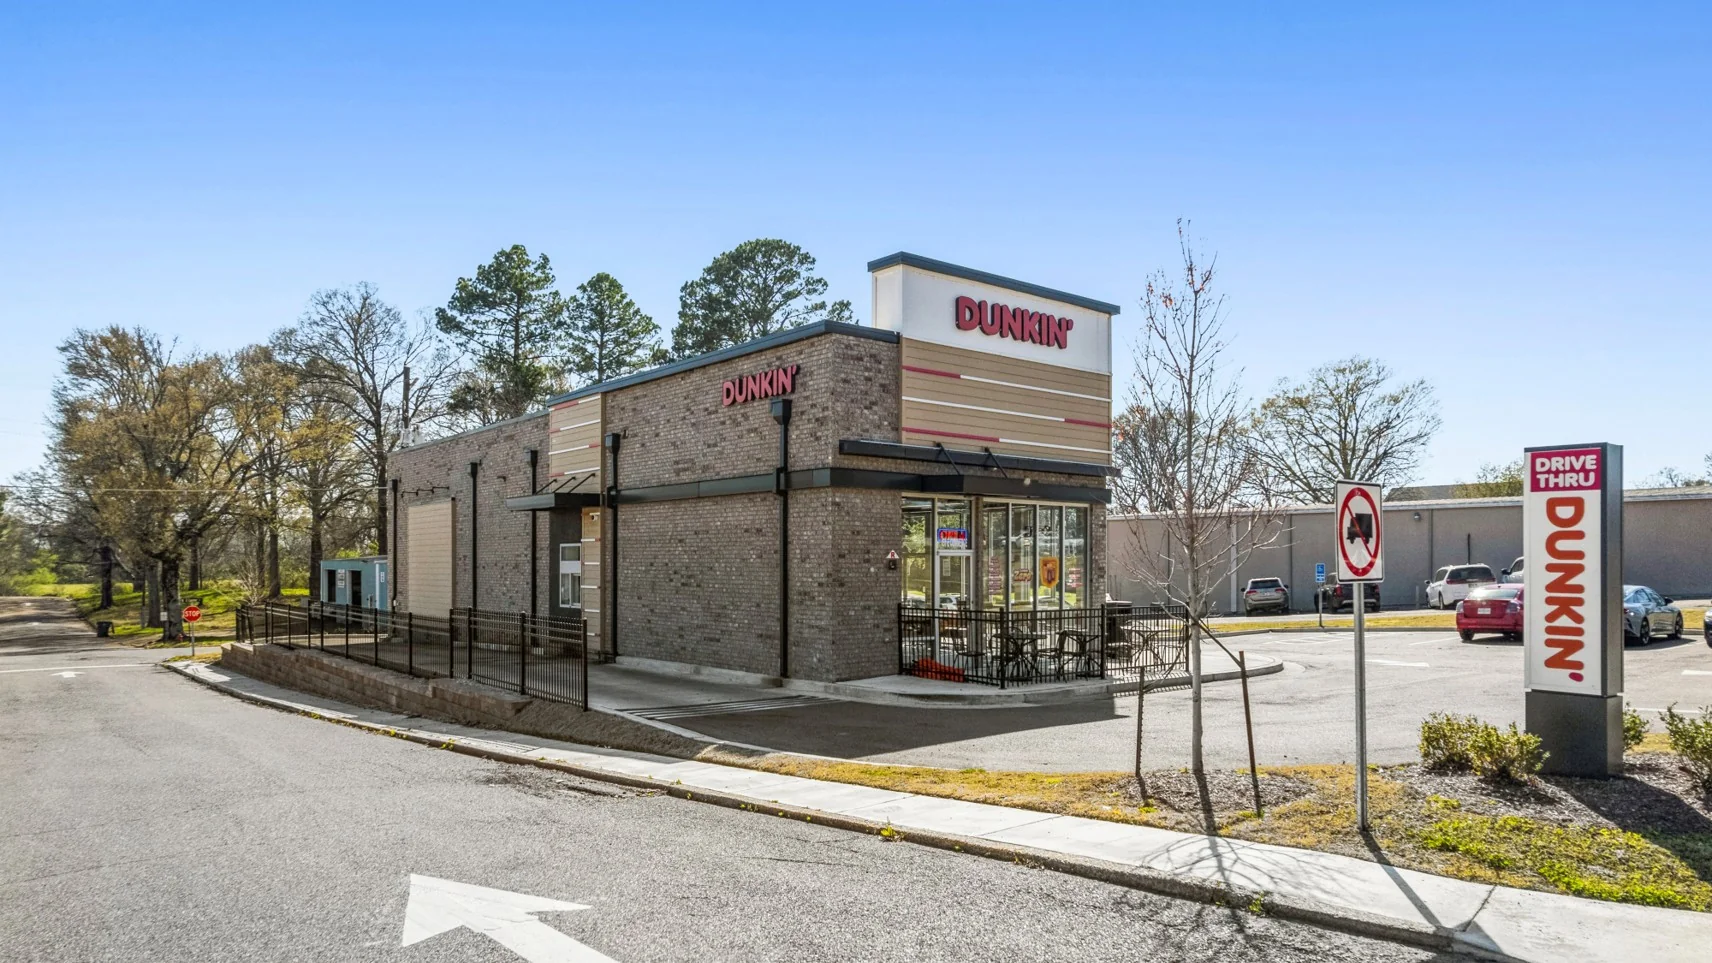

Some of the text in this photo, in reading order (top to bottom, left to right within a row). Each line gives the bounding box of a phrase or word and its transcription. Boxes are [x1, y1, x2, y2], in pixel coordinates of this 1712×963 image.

[956, 296, 1073, 349] DUNKIN'
[722, 364, 798, 407] DUNKIN'
[1535, 455, 1597, 472] DRIVE
[1536, 472, 1596, 488] THRU
[1544, 497, 1586, 682] DUNKIN'
